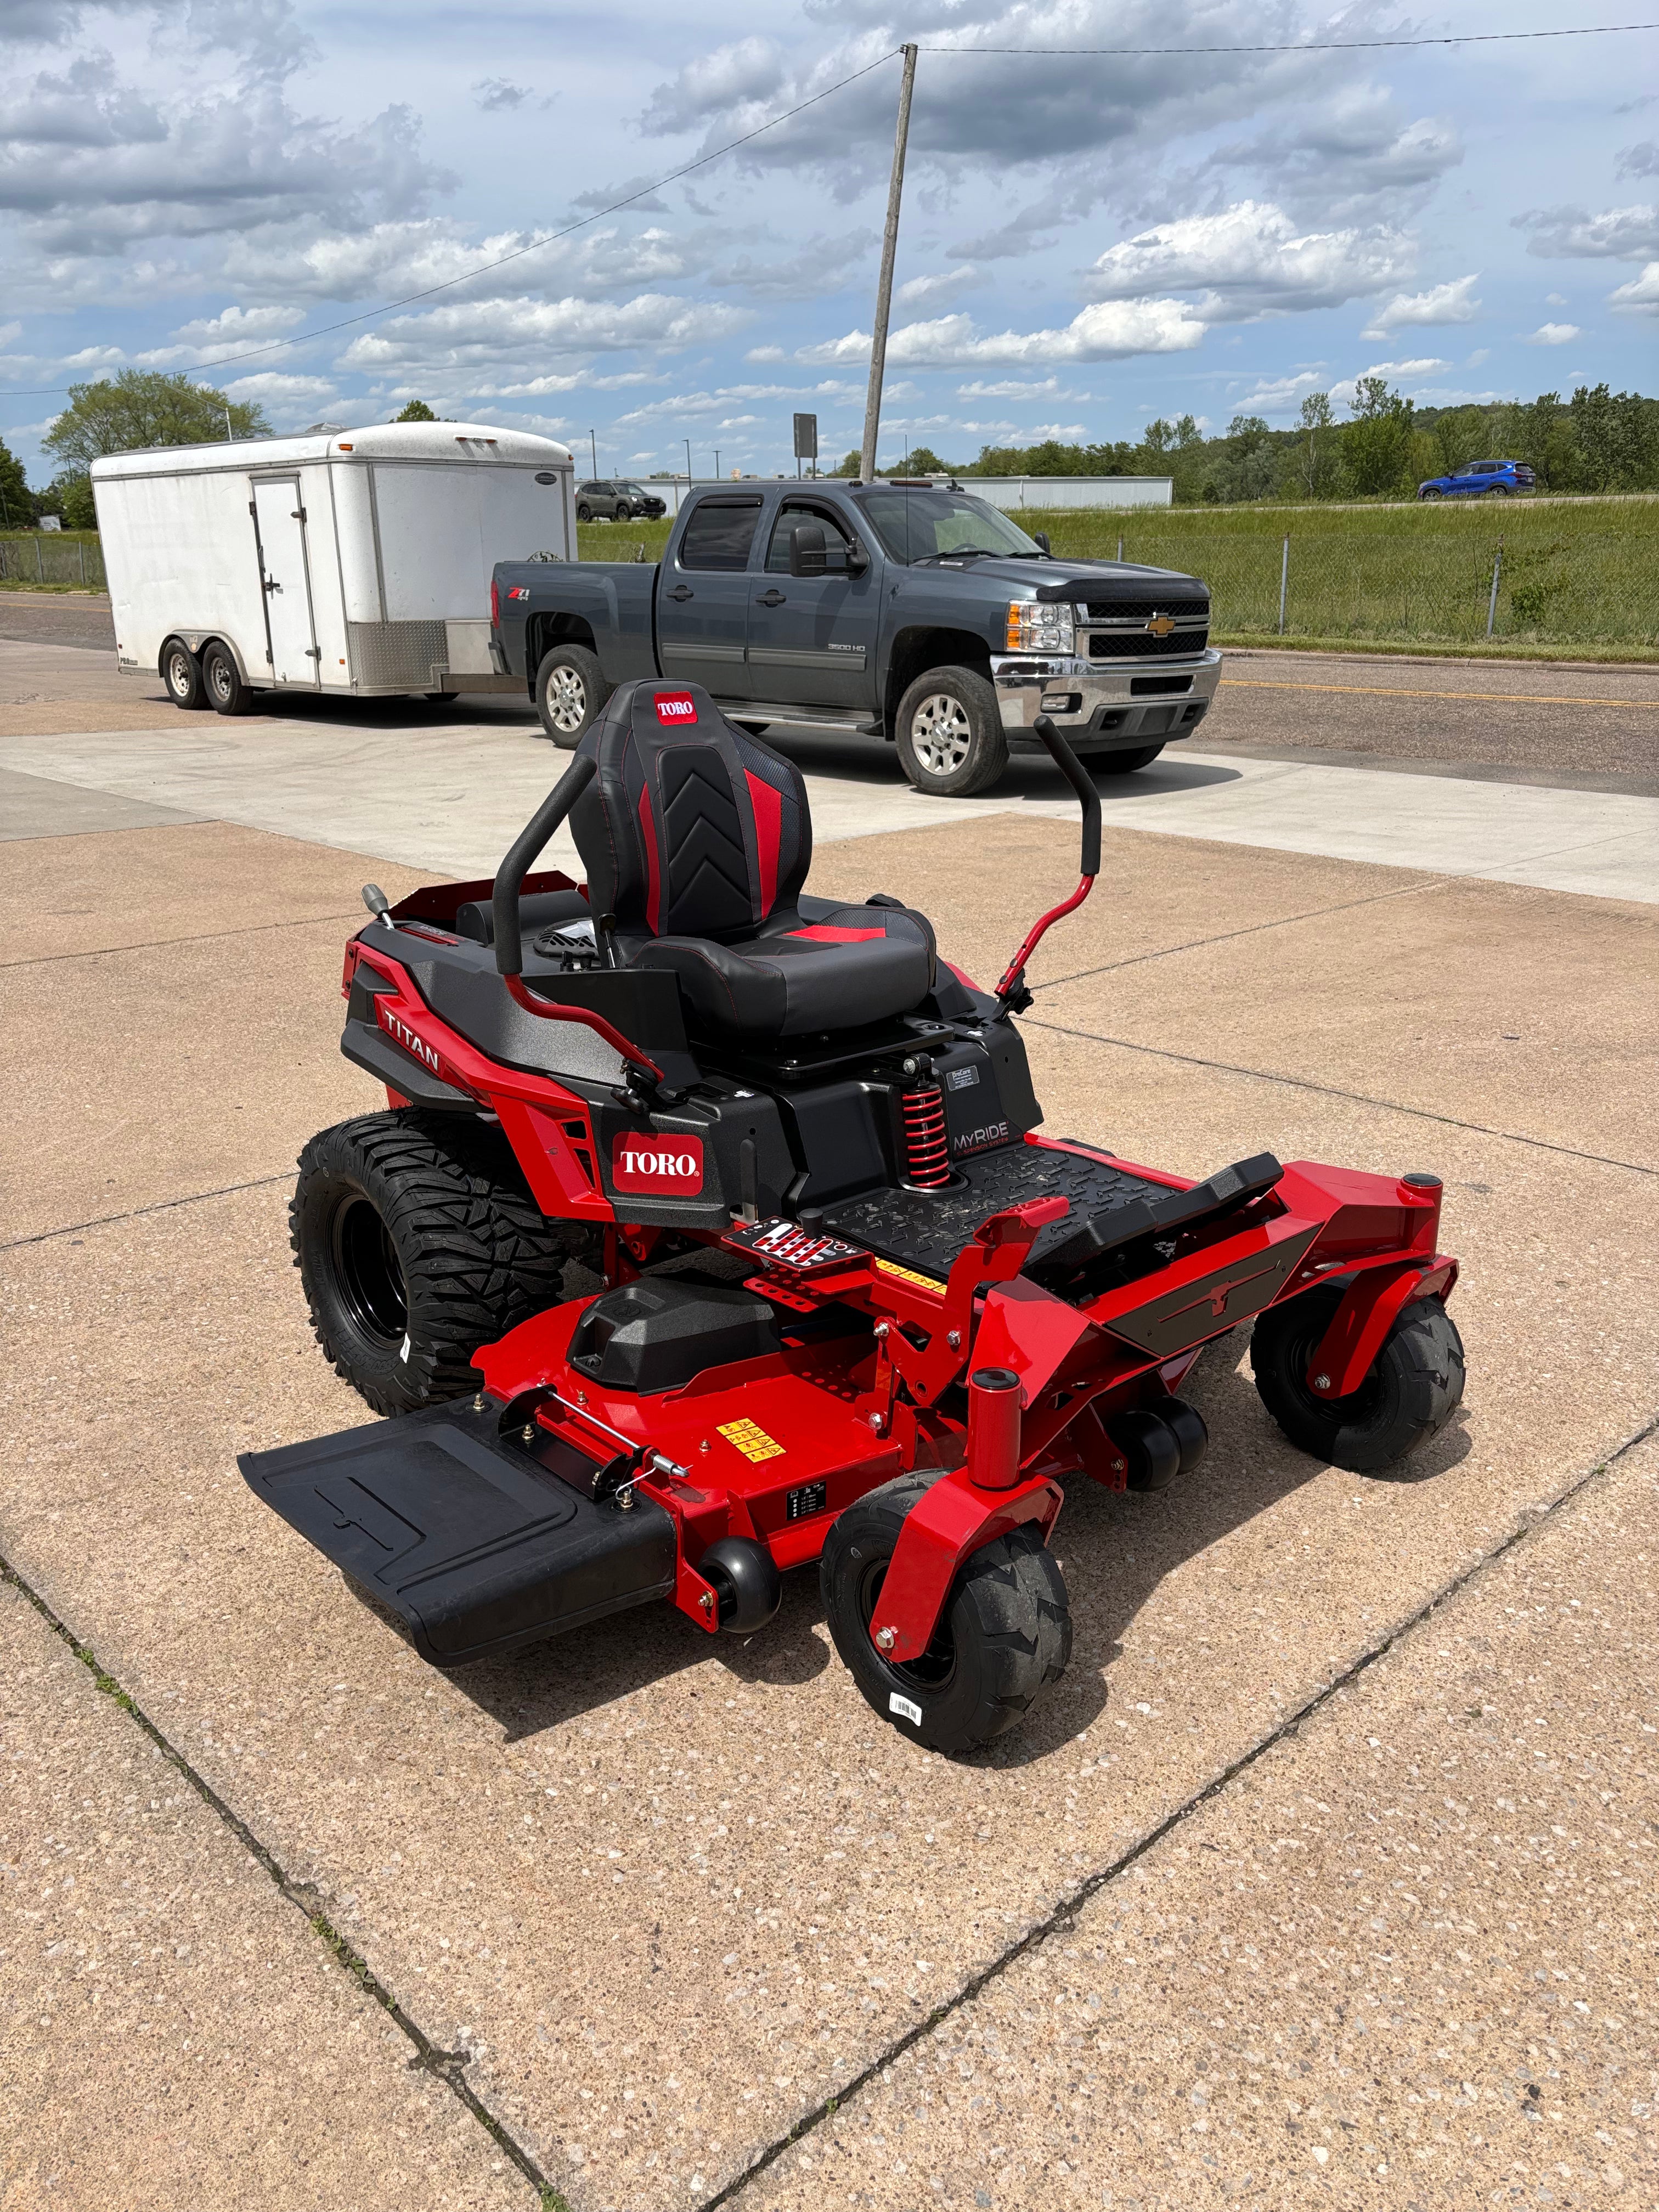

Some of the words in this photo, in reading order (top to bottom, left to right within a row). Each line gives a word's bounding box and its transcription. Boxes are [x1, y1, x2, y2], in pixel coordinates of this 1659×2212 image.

[507, 587, 530, 599] Z71
[657, 701, 693, 716] TORO
[385, 1009, 438, 1071] TITAN
[957, 1143, 988, 1156] SUSPENSION
[989, 1137, 1009, 1147] SYSTEM
[620, 1151, 696, 1176] TORO
